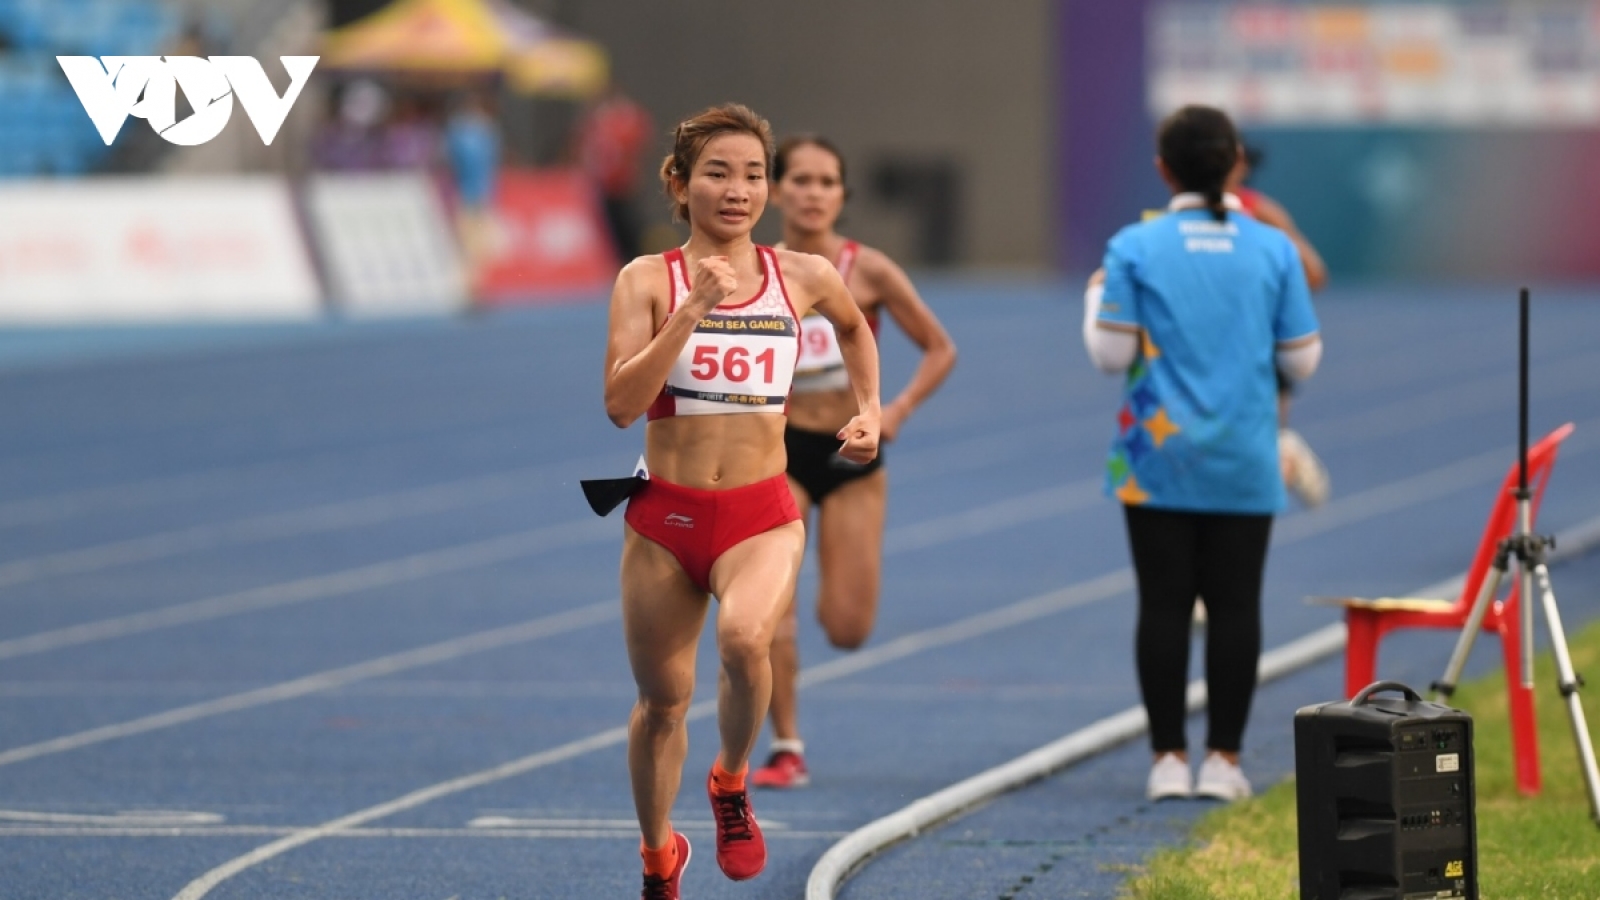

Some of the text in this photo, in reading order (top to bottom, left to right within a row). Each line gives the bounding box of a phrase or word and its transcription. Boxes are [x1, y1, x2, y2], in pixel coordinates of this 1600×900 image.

[700, 319, 786, 331] 32nd SEA GAMES
[690, 345, 776, 384] 561
